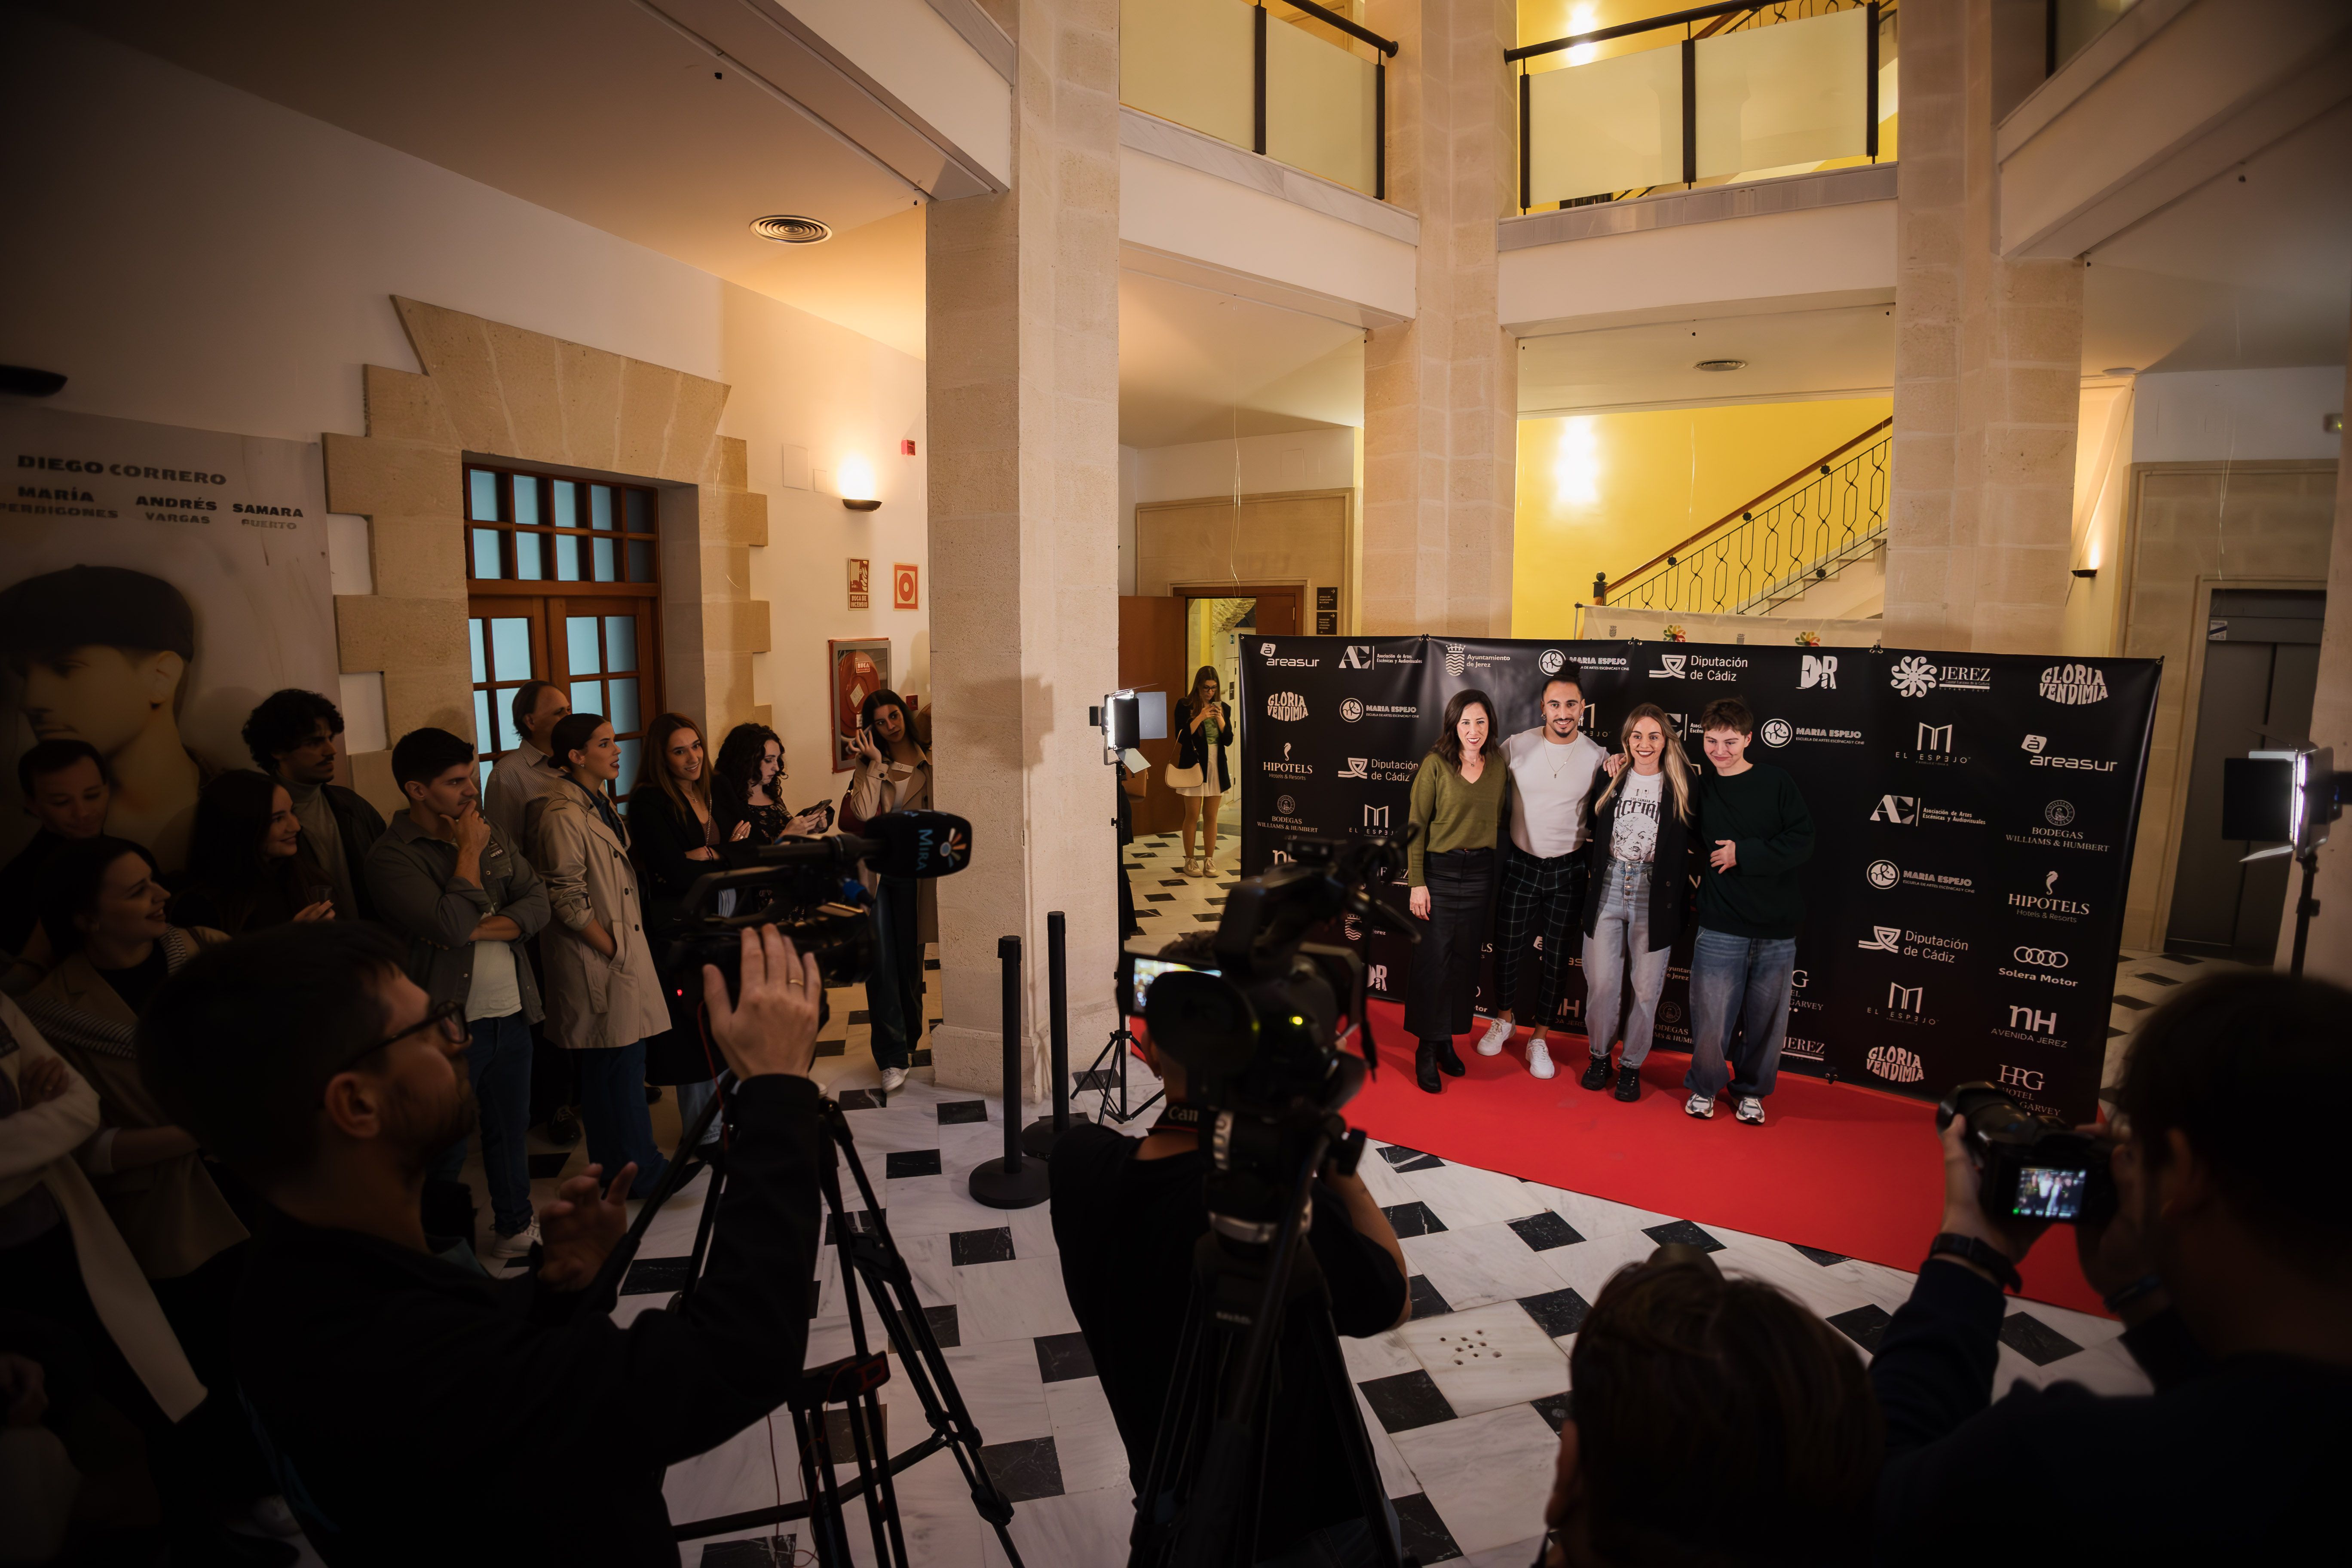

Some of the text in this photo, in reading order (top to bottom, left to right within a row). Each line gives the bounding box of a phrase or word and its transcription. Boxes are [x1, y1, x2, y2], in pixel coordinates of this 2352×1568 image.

[18, 455, 227, 486] DIEGO CORRERO
[18, 486, 94, 502] MARÍA
[136, 497, 217, 511] ANDRÉS
[232, 503, 304, 518] SAMARA
[145, 512, 210, 524] VARGAS
[242, 518, 297, 530] PUERTO
[1267, 658, 1320, 667] areasur
[1690, 655, 1748, 668] Diputación
[1690, 669, 1736, 681] de Cádiz
[1939, 666, 1991, 681] JEREZ
[2041, 664, 2105, 686] GLORIA
[1268, 692, 1306, 707] GLORIA
[2040, 683, 2108, 704] VENDIMIA
[1268, 706, 1309, 721] VENDIMIA
[1796, 728, 1861, 738] MARIA ESPEJO
[1263, 762, 1313, 774] HIPOTELS
[1372, 759, 1418, 769] Diputación
[2030, 756, 2118, 772] areasur
[1371, 772, 1409, 781] de Cádiz
[1272, 816, 1302, 824] BODEGAS
[1953, 816, 1986, 824] Audiovisuales
[2032, 827, 2083, 839] BODEGAS
[916, 829, 933, 871] MIRA
[2006, 834, 2051, 845] WILLIAMS
[2063, 841, 2110, 852] HUMBERT
[1904, 870, 1972, 886] MARIA ESPEJO
[2008, 894, 2090, 915] HIPOTELS
[2017, 909, 2040, 918] Hotels
[2049, 913, 2077, 923] Resorts
[1905, 931, 1969, 951] Diputación
[1904, 946, 1955, 963] de Cádiz
[1672, 973, 1689, 981] Jerez
[1998, 968, 2078, 987] Solera Motor
[2009, 1005, 2057, 1035] nH
[1655, 1024, 1688, 1035] ODEGAS
[1782, 1036, 1825, 1054] JEREZ
[1991, 1028, 2067, 1048] AVENIDA JEREZ
[1868, 1046, 1923, 1069] GLORIA
[1866, 1058, 1924, 1082] VENDIMIA
[1997, 1064, 2045, 1090] HPG
[2020, 1101, 2061, 1116] GARVEY
